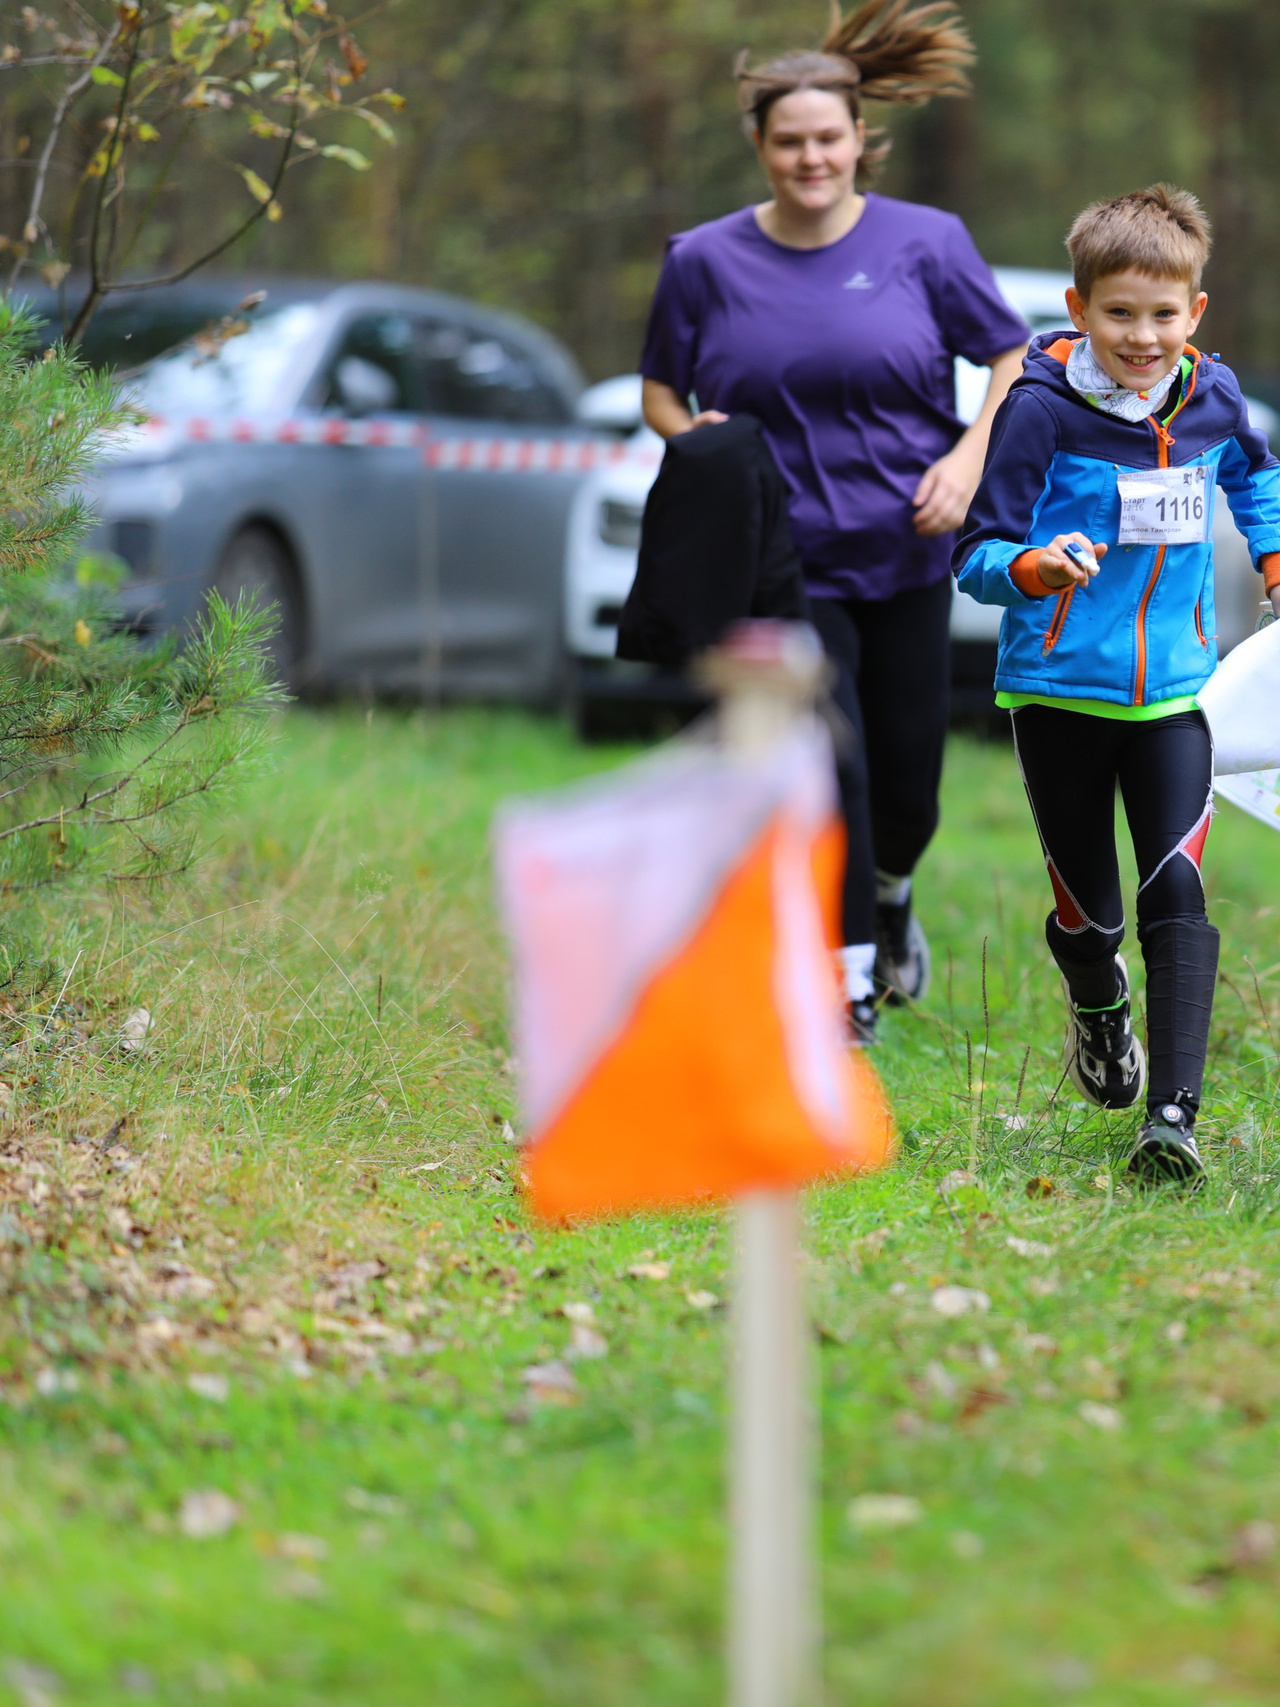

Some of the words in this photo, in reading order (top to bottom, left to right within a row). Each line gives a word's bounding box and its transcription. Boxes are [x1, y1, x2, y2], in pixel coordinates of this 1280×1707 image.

[1123, 497, 1146, 505] Старт
[1123, 504, 1144, 512] 12:16
[1155, 495, 1203, 522] 1116
